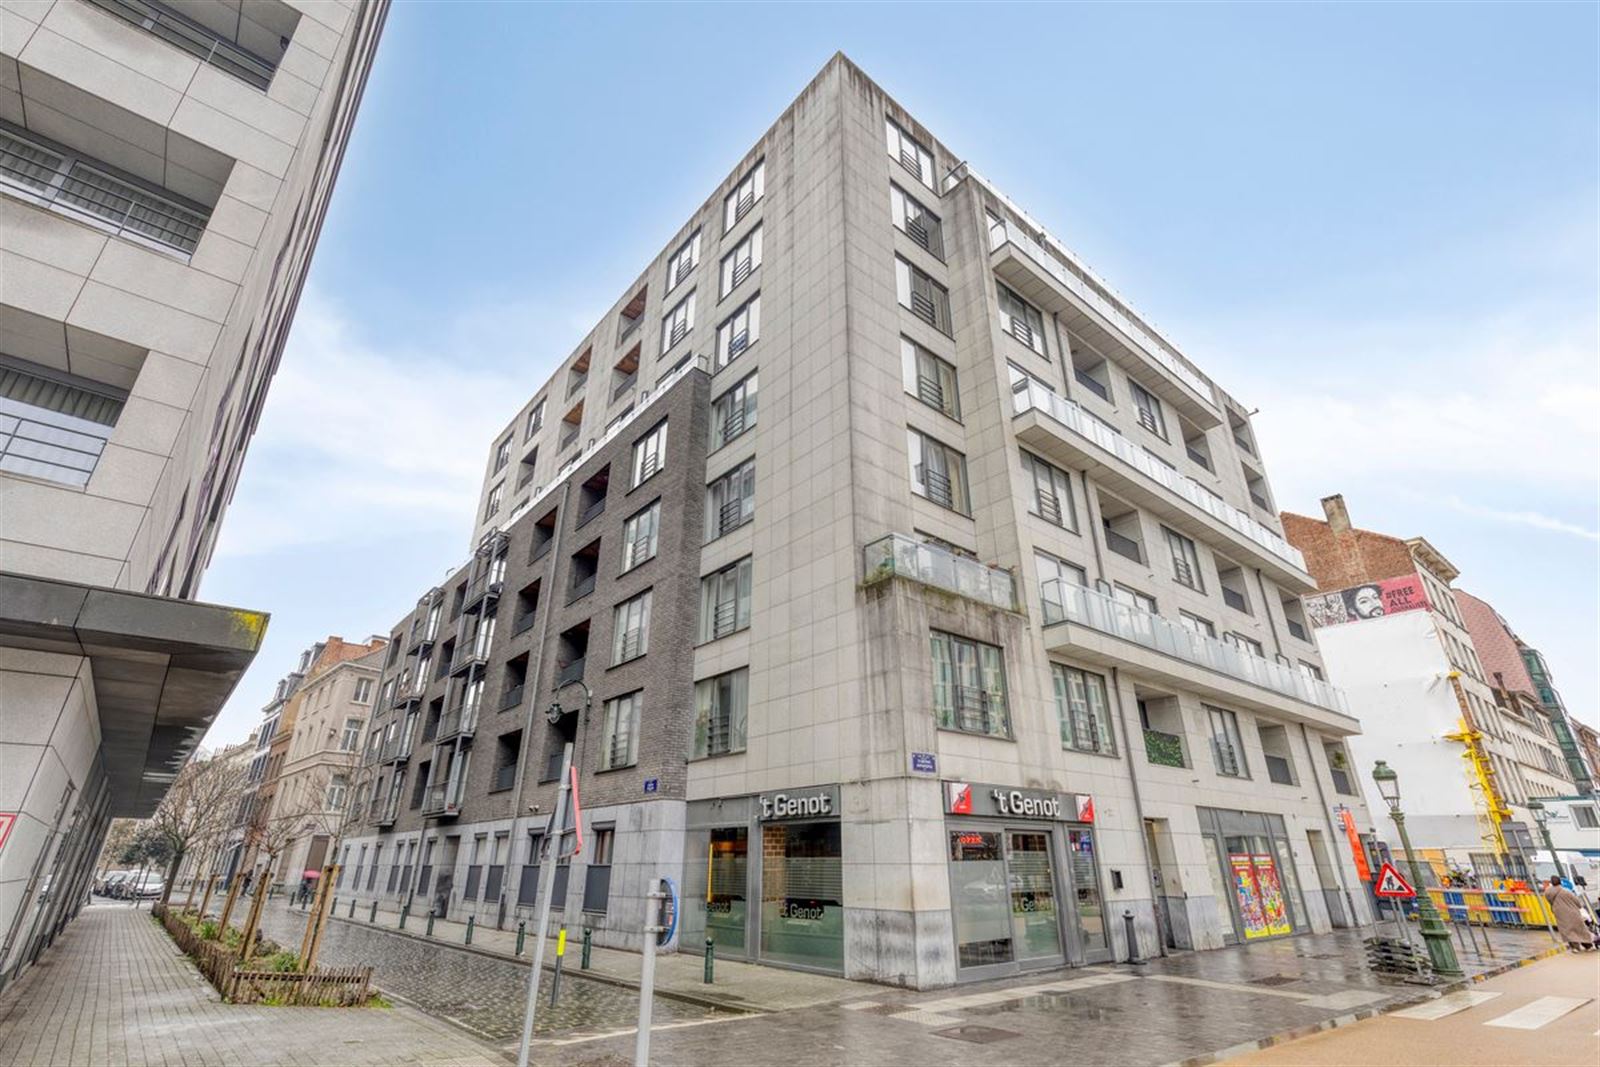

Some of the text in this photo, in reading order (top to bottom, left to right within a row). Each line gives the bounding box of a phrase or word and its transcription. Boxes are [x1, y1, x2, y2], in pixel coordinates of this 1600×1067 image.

[1385, 586, 1414, 599] #FREE
[1390, 597, 1411, 607] ALL
[775, 792, 831, 816] Genot
[1010, 790, 1060, 817] Genot
[790, 902, 825, 919] Genot
